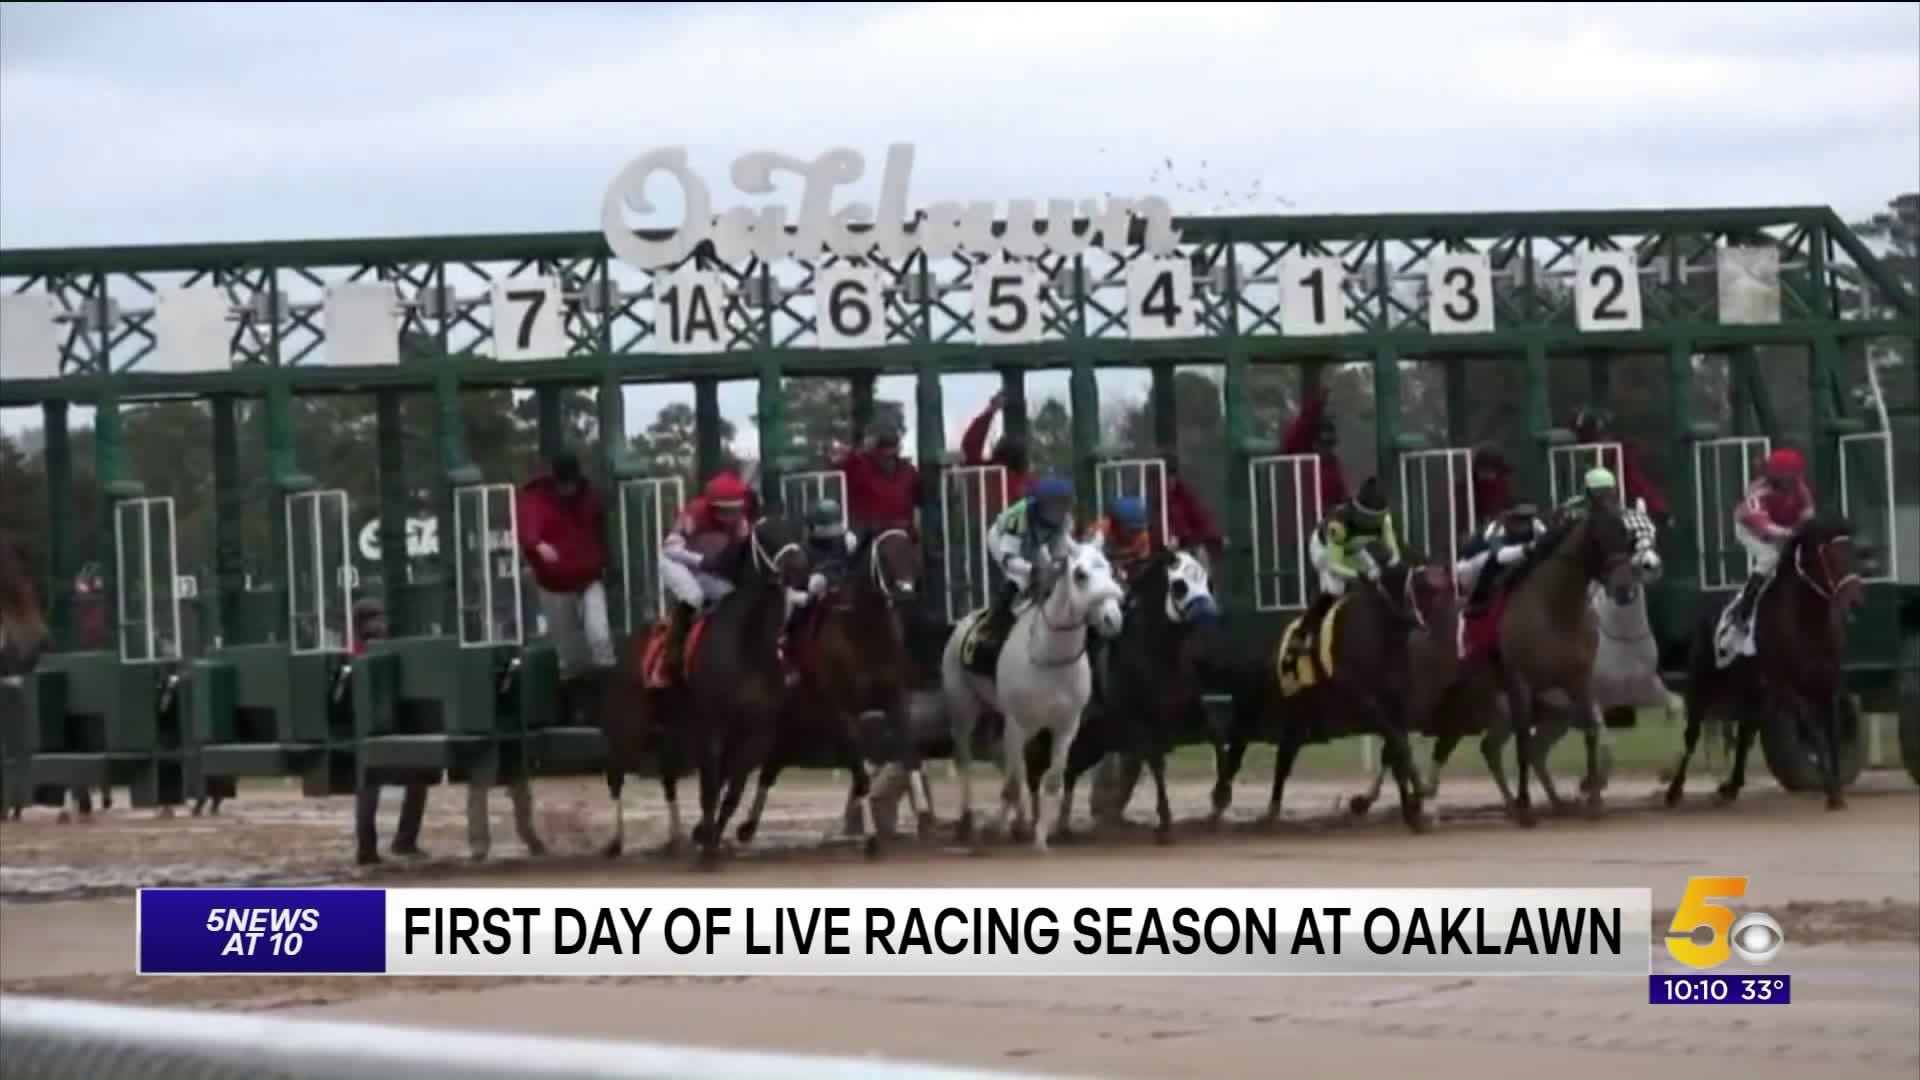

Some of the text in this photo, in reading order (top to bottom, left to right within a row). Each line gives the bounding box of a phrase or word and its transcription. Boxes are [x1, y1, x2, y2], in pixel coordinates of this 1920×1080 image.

[601, 143, 1181, 270] Oaklawn
[507, 291, 545, 348] 7
[664, 284, 718, 342] 1A
[829, 279, 871, 337] 6
[989, 276, 1027, 332] 5
[1142, 271, 1182, 328] 4
[1299, 268, 1325, 324] 1
[1443, 267, 1479, 322] 3
[1591, 266, 1628, 320] 2
